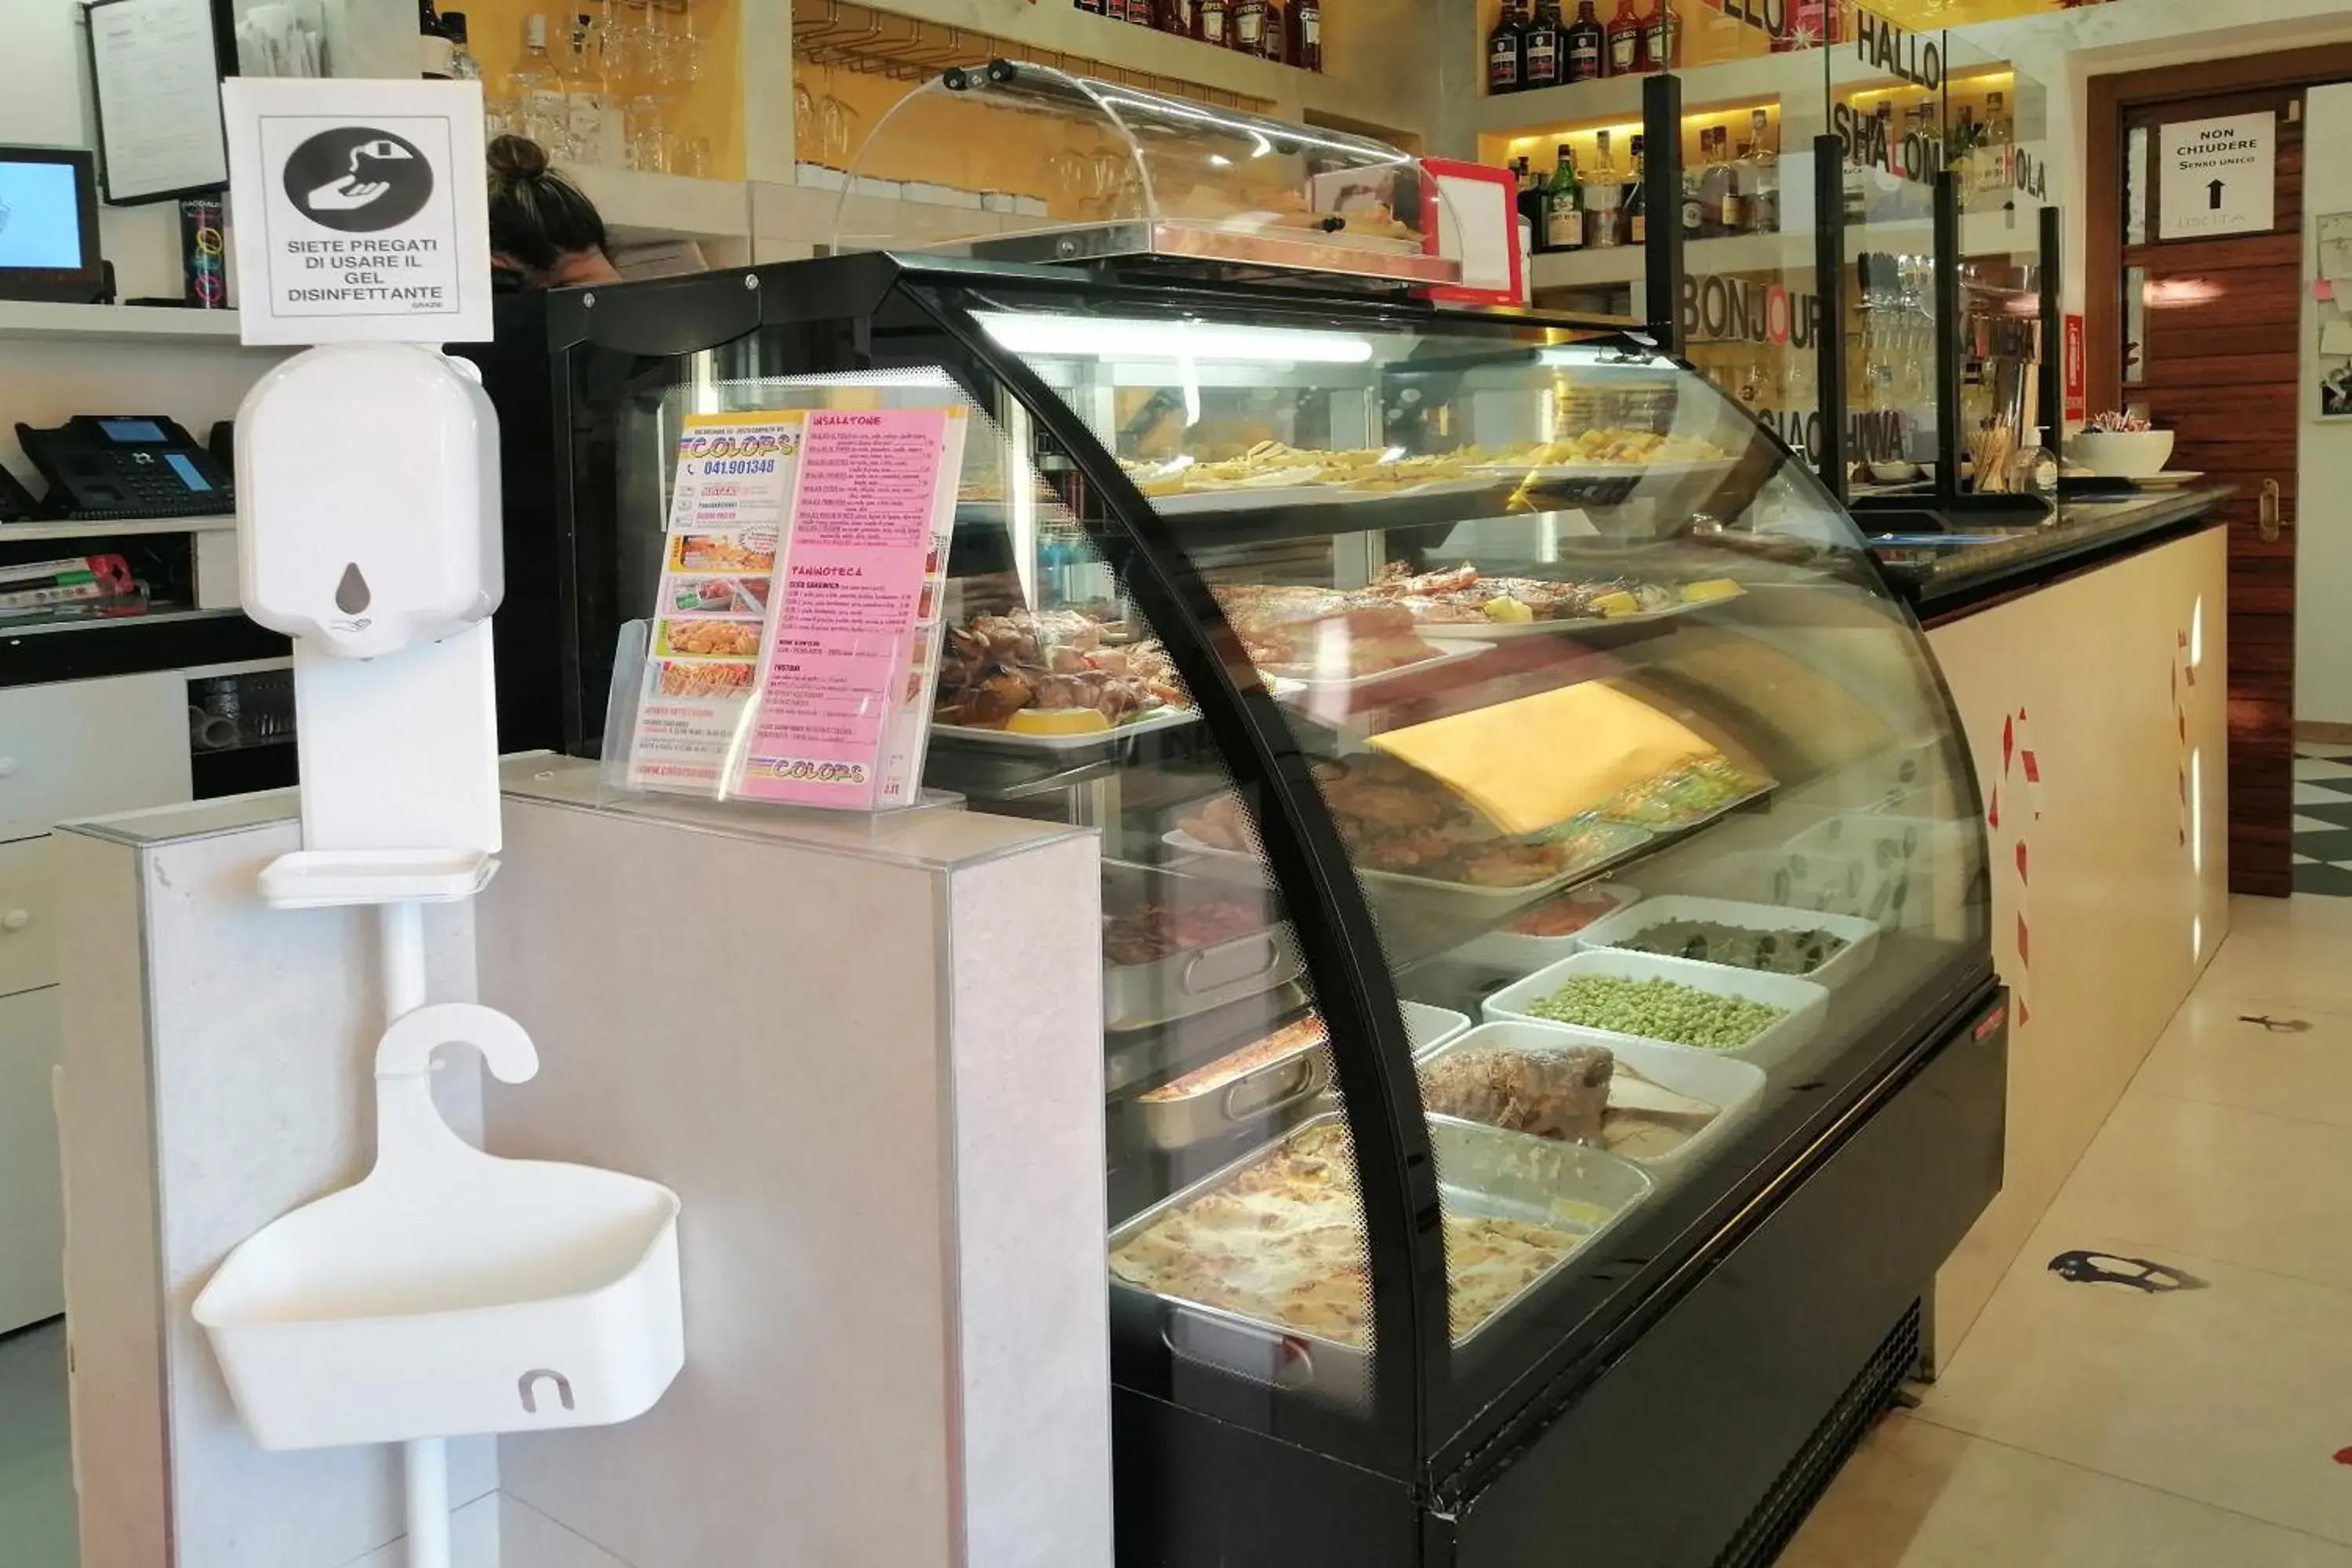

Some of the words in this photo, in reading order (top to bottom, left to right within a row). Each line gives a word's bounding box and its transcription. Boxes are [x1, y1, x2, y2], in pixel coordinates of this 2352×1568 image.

[1857, 9, 1940, 91] HALLO
[2200, 128, 2234, 140] NON
[1834, 103, 1940, 187] SHALOM
[2176, 139, 2258, 156] CHIUDERE
[2002, 144, 2047, 202] HOLA
[287, 240, 344, 253] SIETE
[350, 238, 438, 252] PREGATI
[305, 256, 325, 269] DI
[331, 255, 399, 268] USARE
[405, 255, 423, 267] IL
[343, 271, 386, 285] GEL
[287, 285, 443, 301] DISINFETTANTE
[812, 416, 882, 426] INSALATONE
[689, 434, 793, 458] COLORS
[703, 459, 775, 474] 041.901348
[772, 759, 865, 783] COLORS
